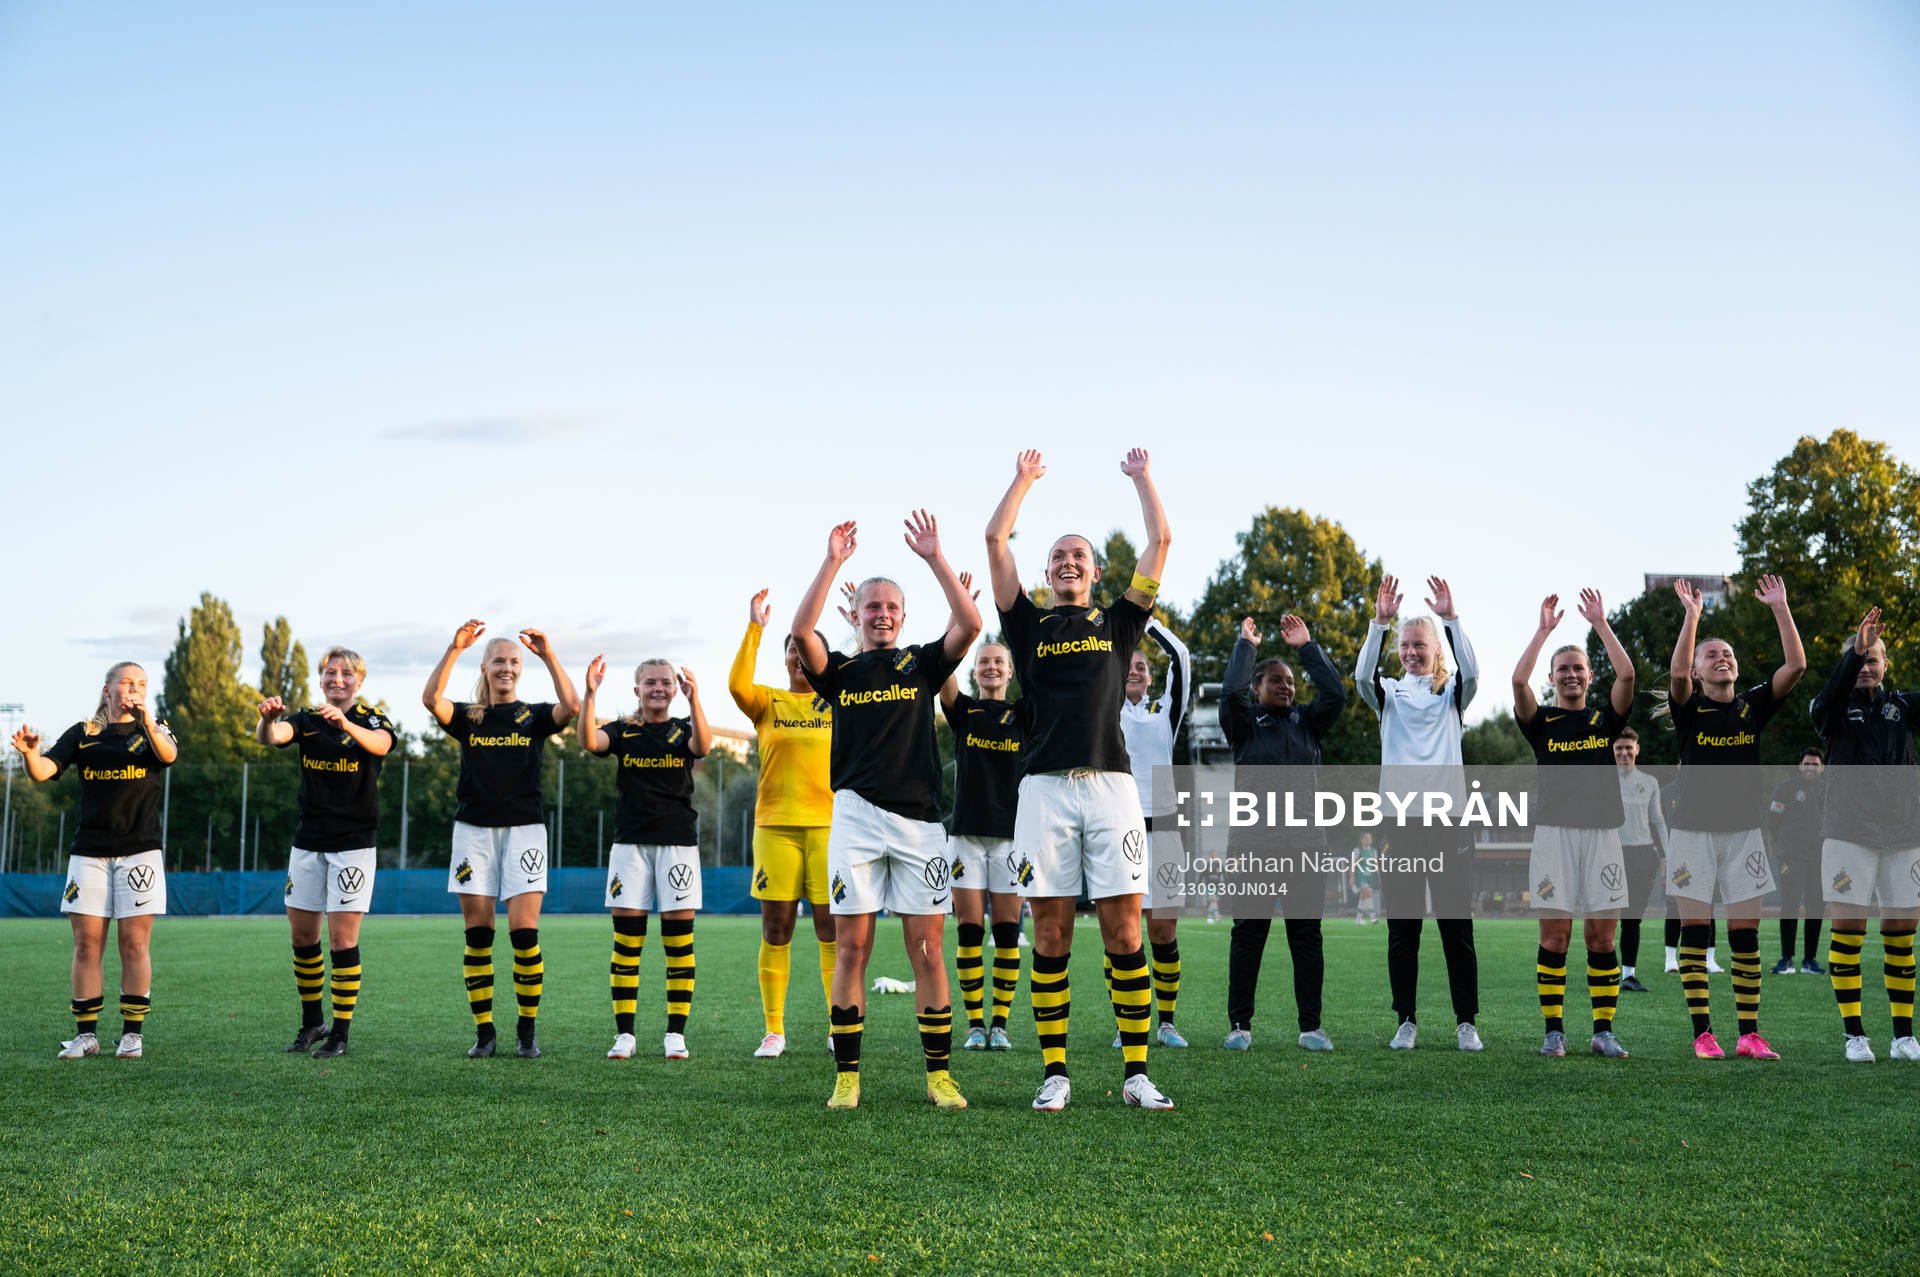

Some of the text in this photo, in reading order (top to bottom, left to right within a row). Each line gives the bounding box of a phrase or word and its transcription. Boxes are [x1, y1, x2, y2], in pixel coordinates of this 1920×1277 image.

[1037, 635, 1112, 658] truecaller
[839, 684, 918, 707] truecaller
[773, 717, 832, 729] truecaller
[468, 732, 531, 748] truecaller
[966, 733, 1020, 752] truecaller
[1548, 735, 1609, 753] truecaller
[1697, 731, 1755, 747] truecaller
[303, 755, 359, 773] truecaller
[623, 753, 684, 768] truecaller
[83, 764, 147, 781] truecaller
